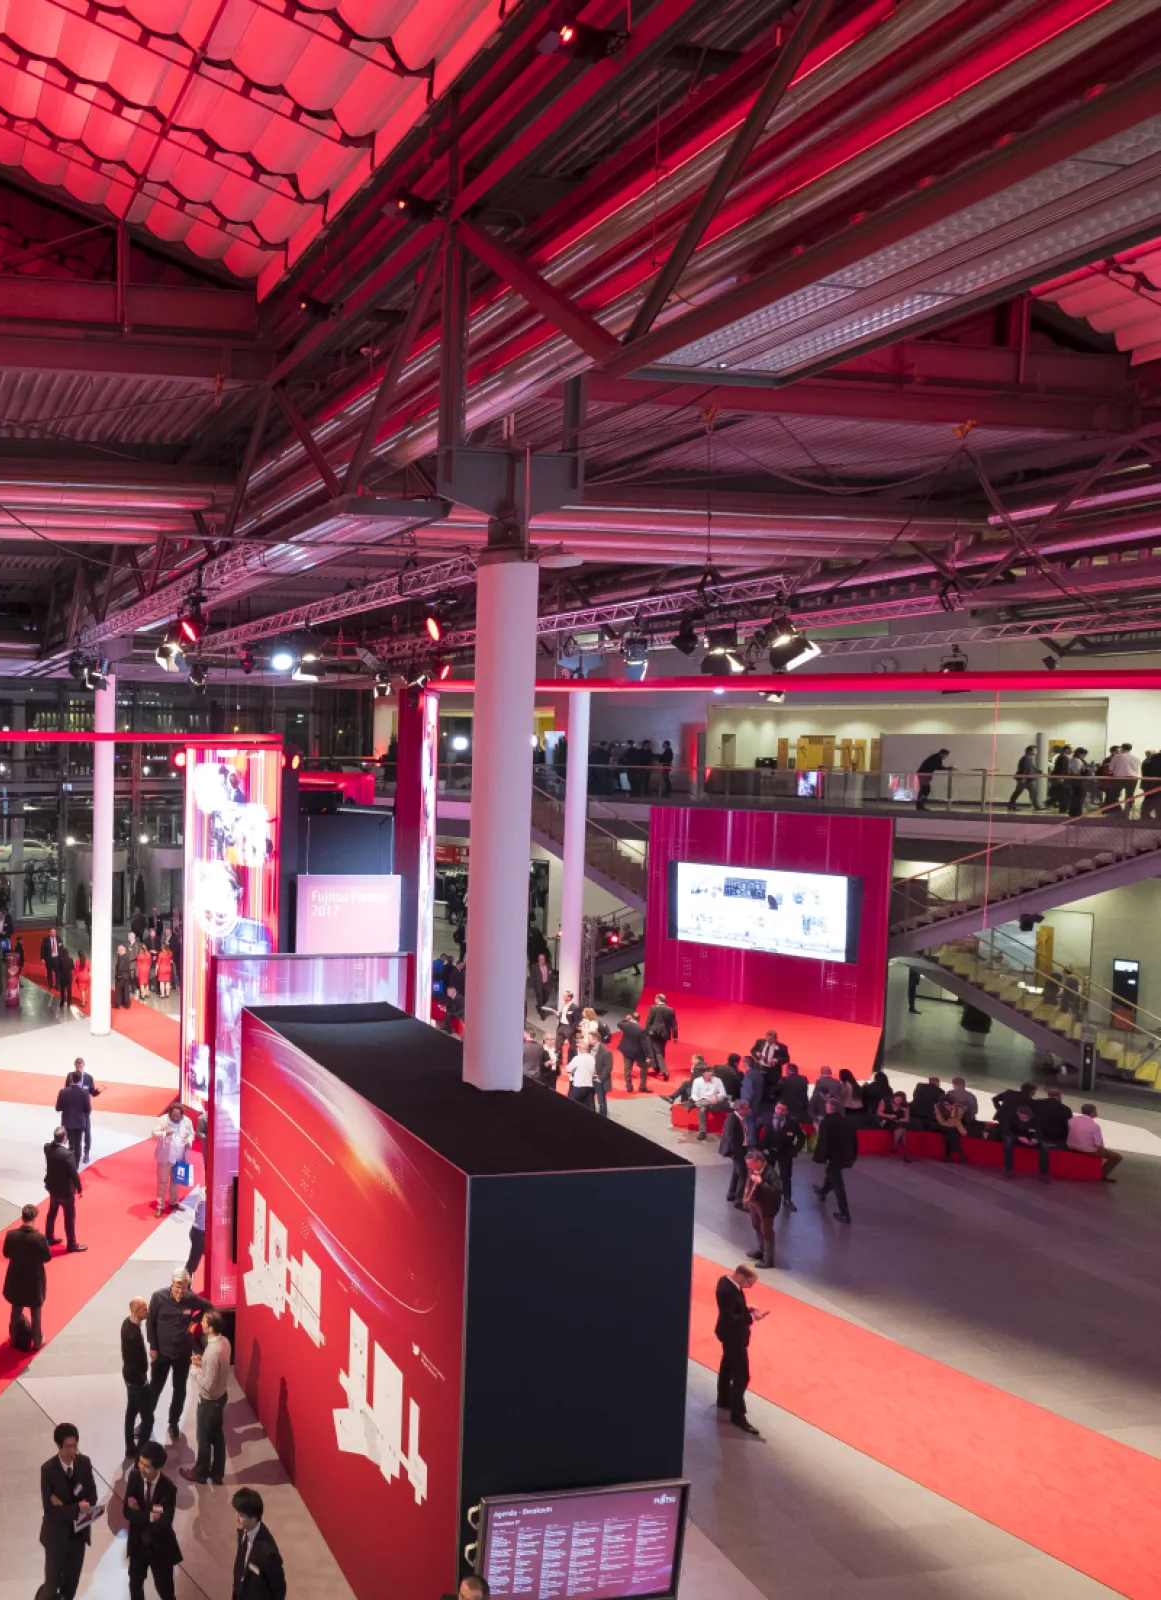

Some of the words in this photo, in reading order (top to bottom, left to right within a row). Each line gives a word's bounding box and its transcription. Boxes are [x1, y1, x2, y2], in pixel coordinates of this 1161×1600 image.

[311, 890, 348, 905] Fujitsu
[352, 890, 387, 903] Forum
[311, 905, 339, 917] 2017
[493, 1509, 518, 1519] Agenda
